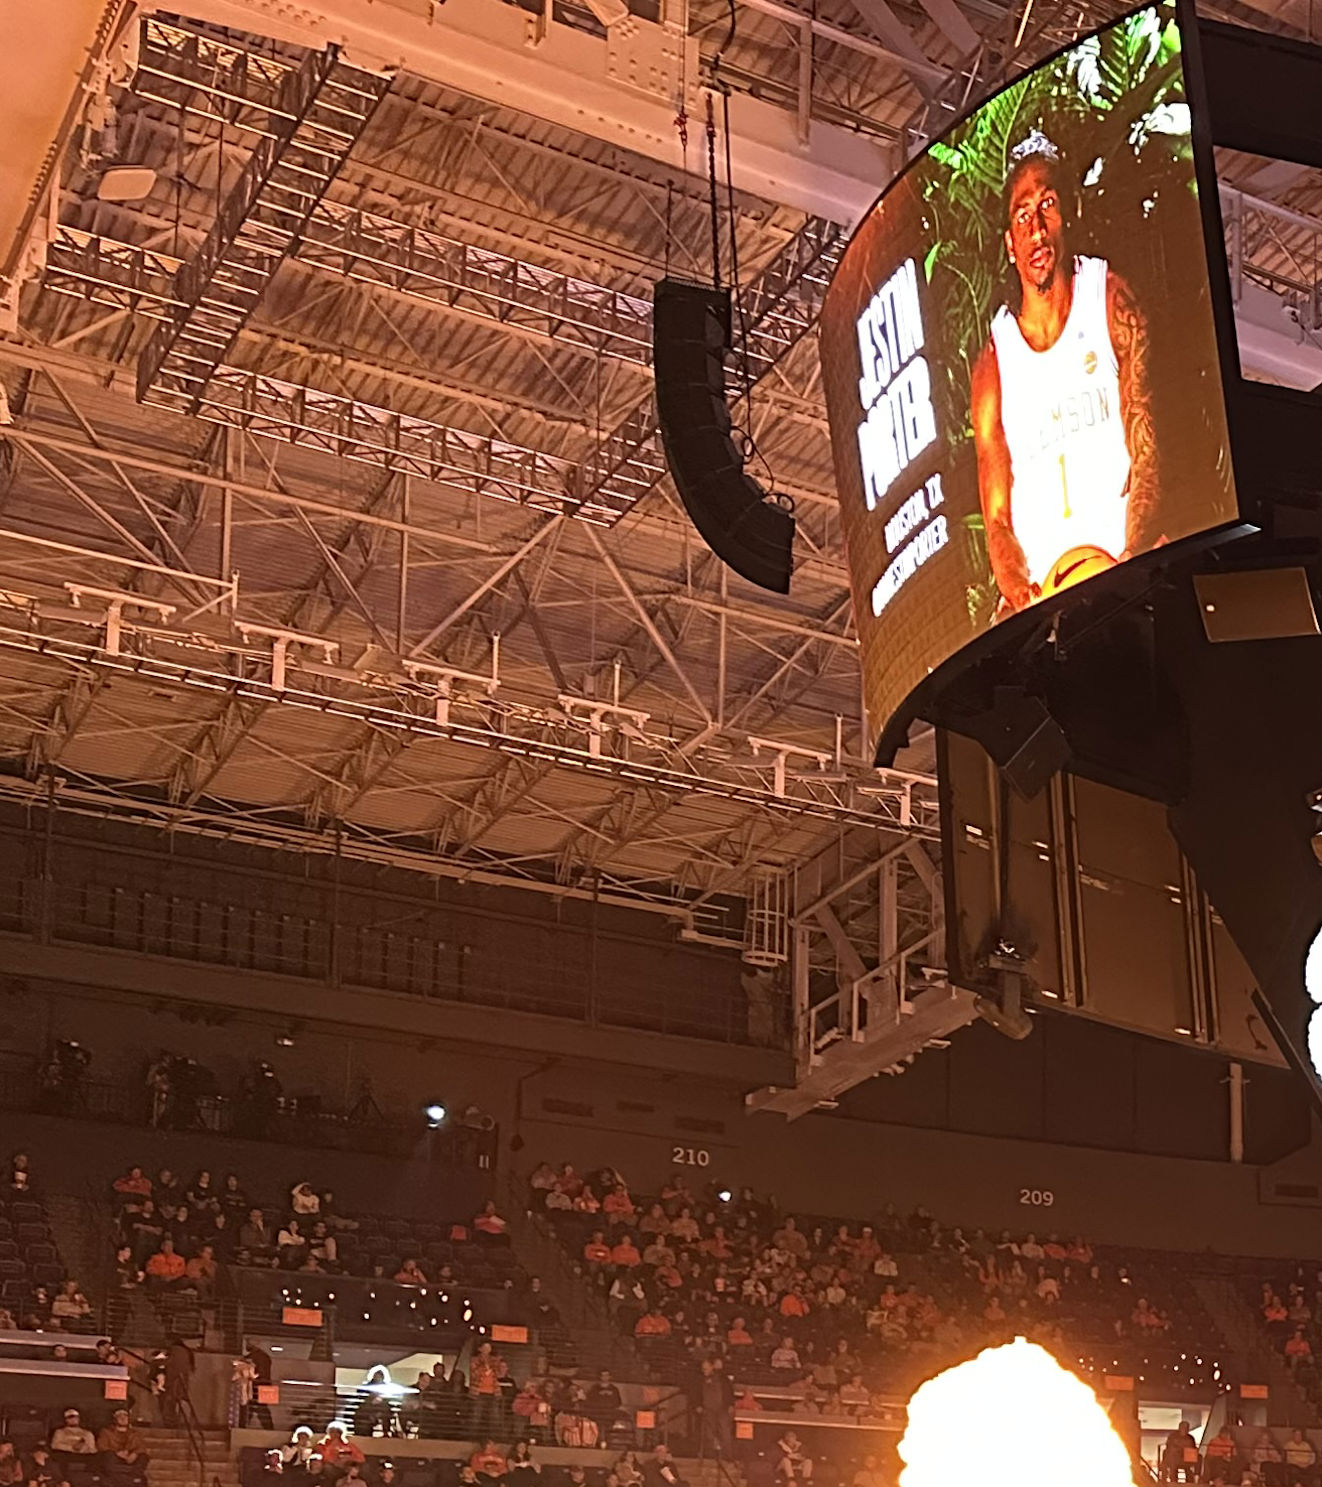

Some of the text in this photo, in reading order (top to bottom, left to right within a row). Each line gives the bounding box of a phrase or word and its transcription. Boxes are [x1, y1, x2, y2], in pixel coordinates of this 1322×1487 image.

[857, 257, 924, 411] JESTIN
[672, 1146, 710, 1168] 210
[1020, 1188, 1054, 1207] 209
